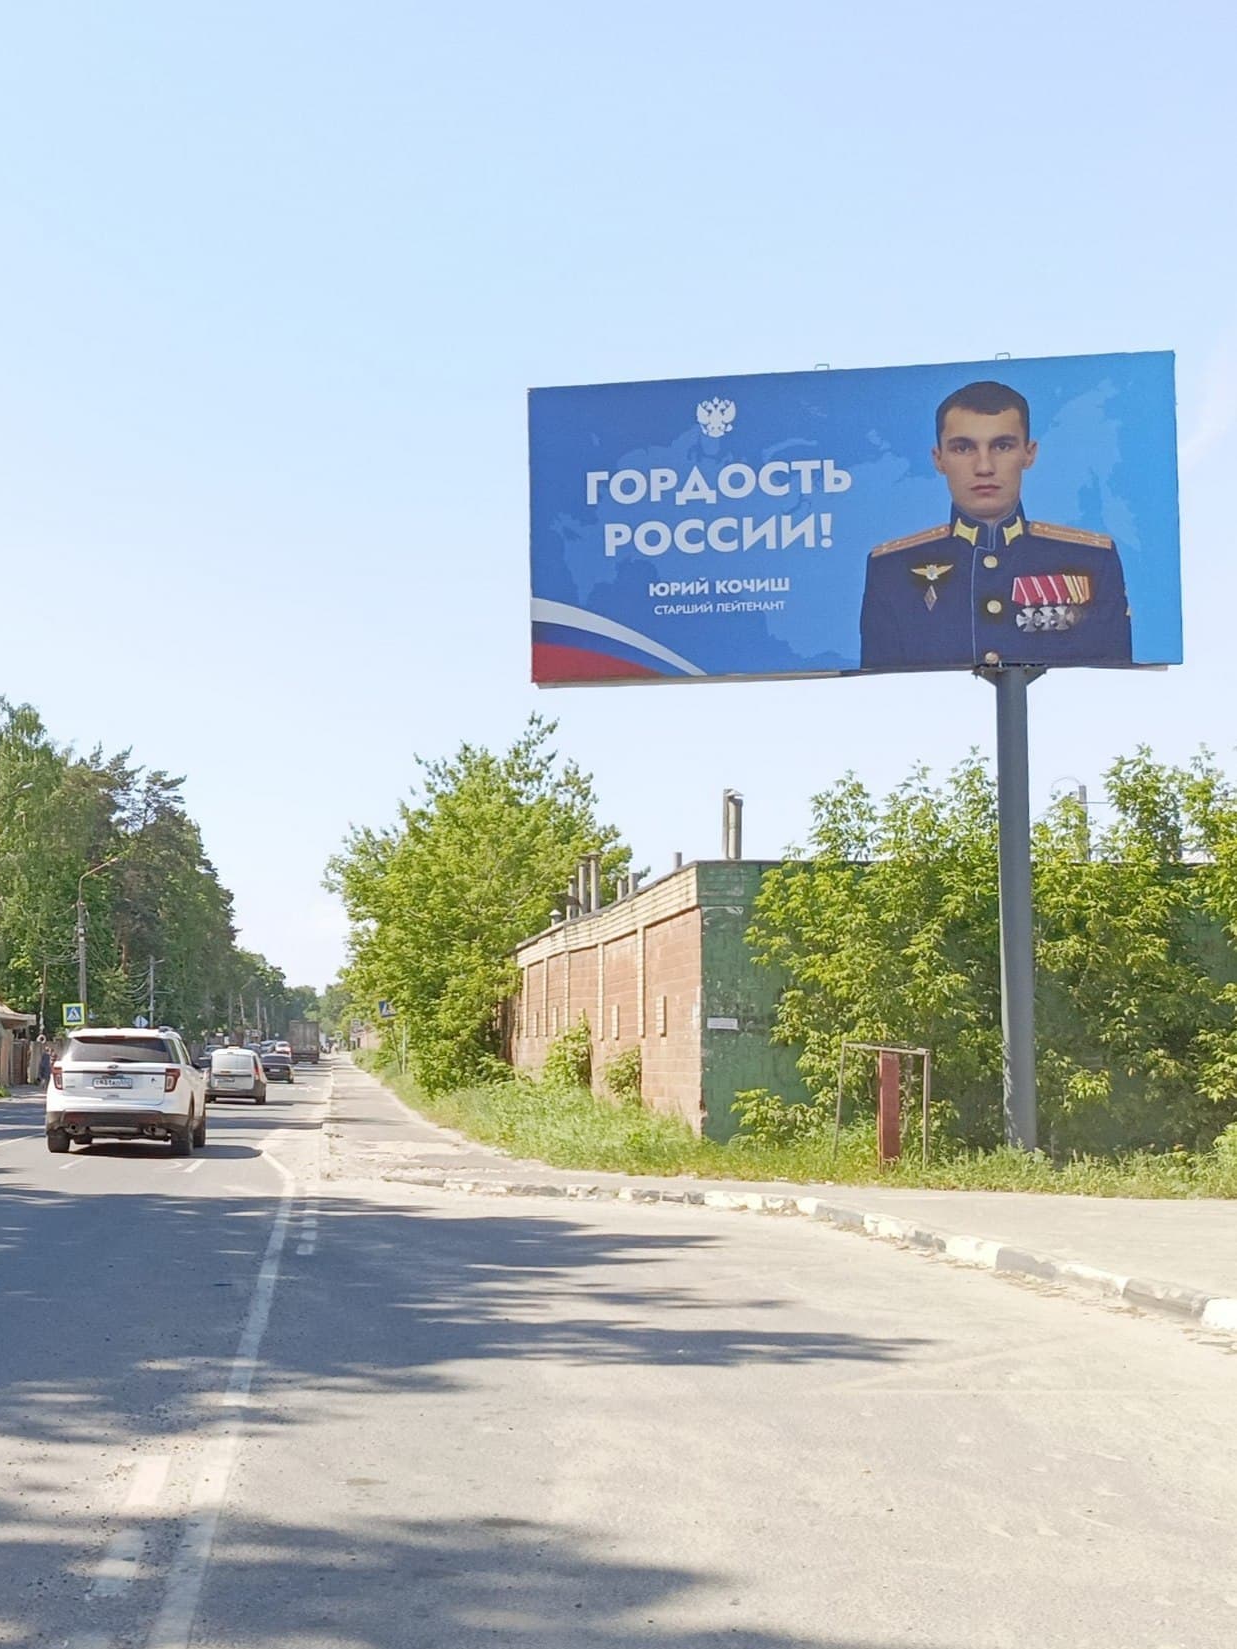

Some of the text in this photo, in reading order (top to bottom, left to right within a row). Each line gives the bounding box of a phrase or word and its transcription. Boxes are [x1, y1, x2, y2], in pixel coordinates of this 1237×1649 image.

[586, 459, 852, 505] ГОРДОСТЬ
[604, 513, 833, 556] РОССИИ!
[649, 577, 790, 597] ЮРИЙ КОЧИШ
[654, 600, 785, 615] СТАРШИЙ ЛЕЙТЕНАНТ
